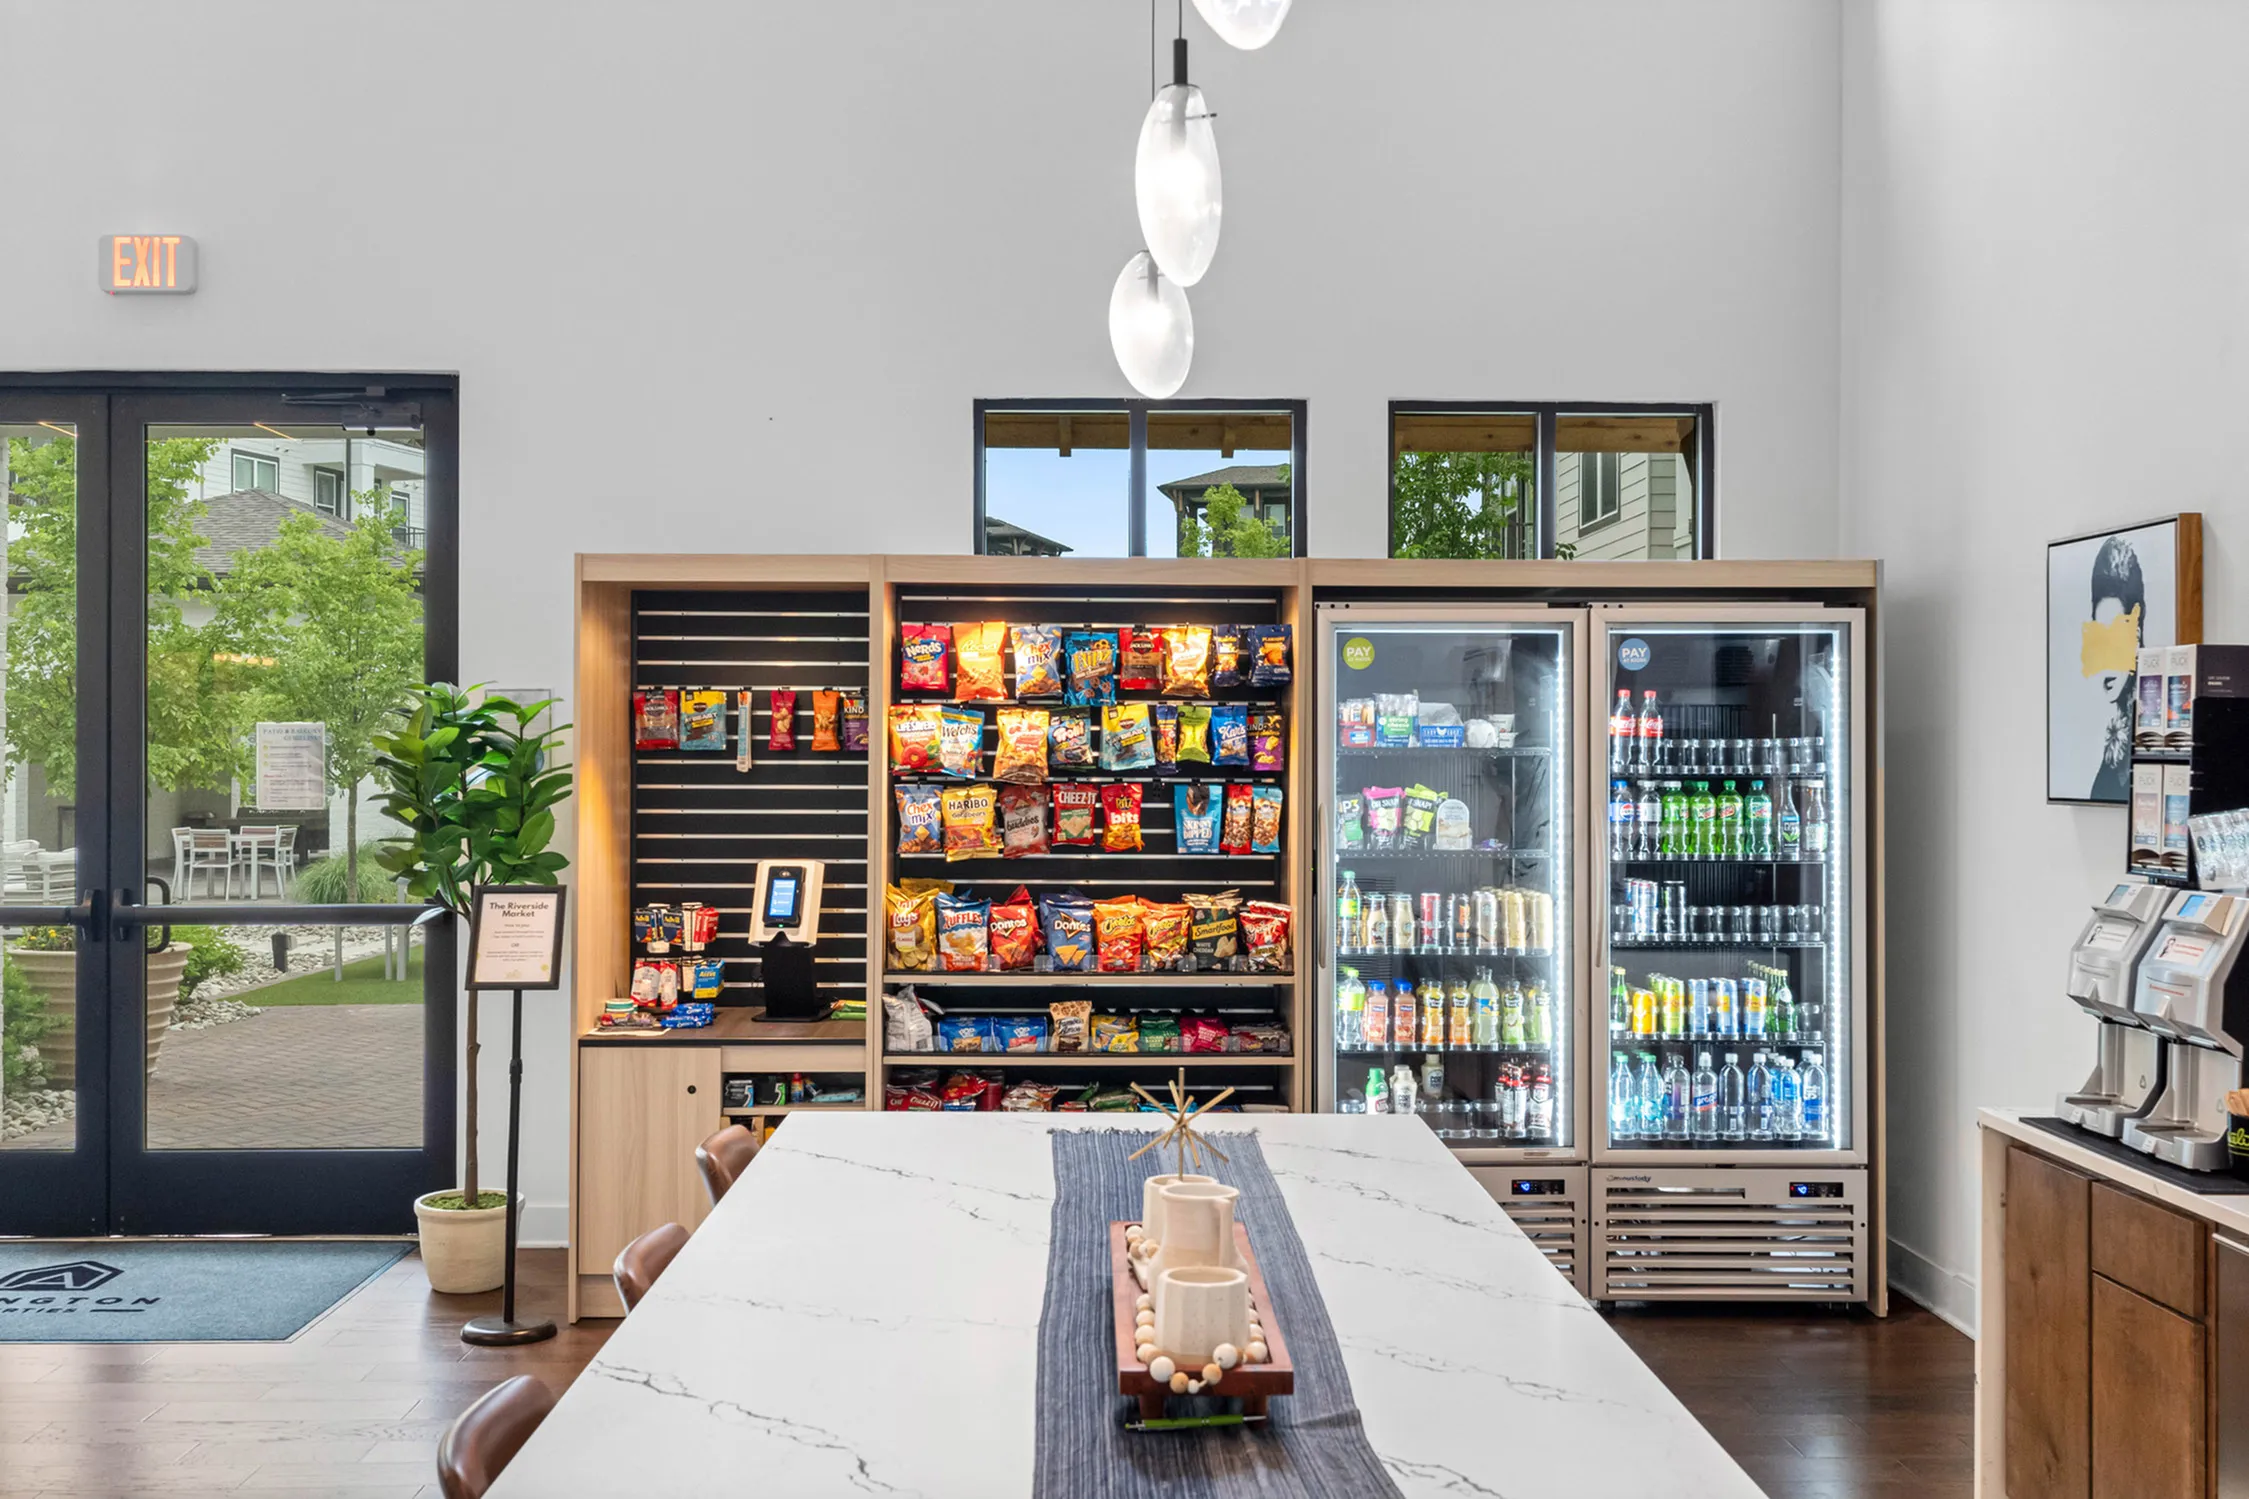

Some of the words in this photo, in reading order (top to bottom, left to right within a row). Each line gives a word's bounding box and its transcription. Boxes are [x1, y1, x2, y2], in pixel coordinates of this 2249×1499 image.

[112, 235, 181, 289] EXIT
[1346, 646, 1371, 657] PAY
[1622, 647, 1647, 658] PAY
[844, 706, 865, 714] KIND
[942, 723, 977, 738] Welch's
[906, 801, 934, 816] Chex
[948, 798, 989, 810] HARIBO
[1110, 811, 1140, 825] bits
[489, 902, 506, 910] The
[507, 902, 549, 910] Riverside
[502, 909, 535, 918] Market
[943, 910, 984, 929] RUFFLES
[989, 918, 1028, 934] Doritos
[1053, 918, 1091, 935] Doritos
[1102, 915, 1136, 934] Cheetos
[1194, 921, 1236, 937] Smartfood
[743, 1085, 753, 1108] 5
[773, 1083, 786, 1106] 5
